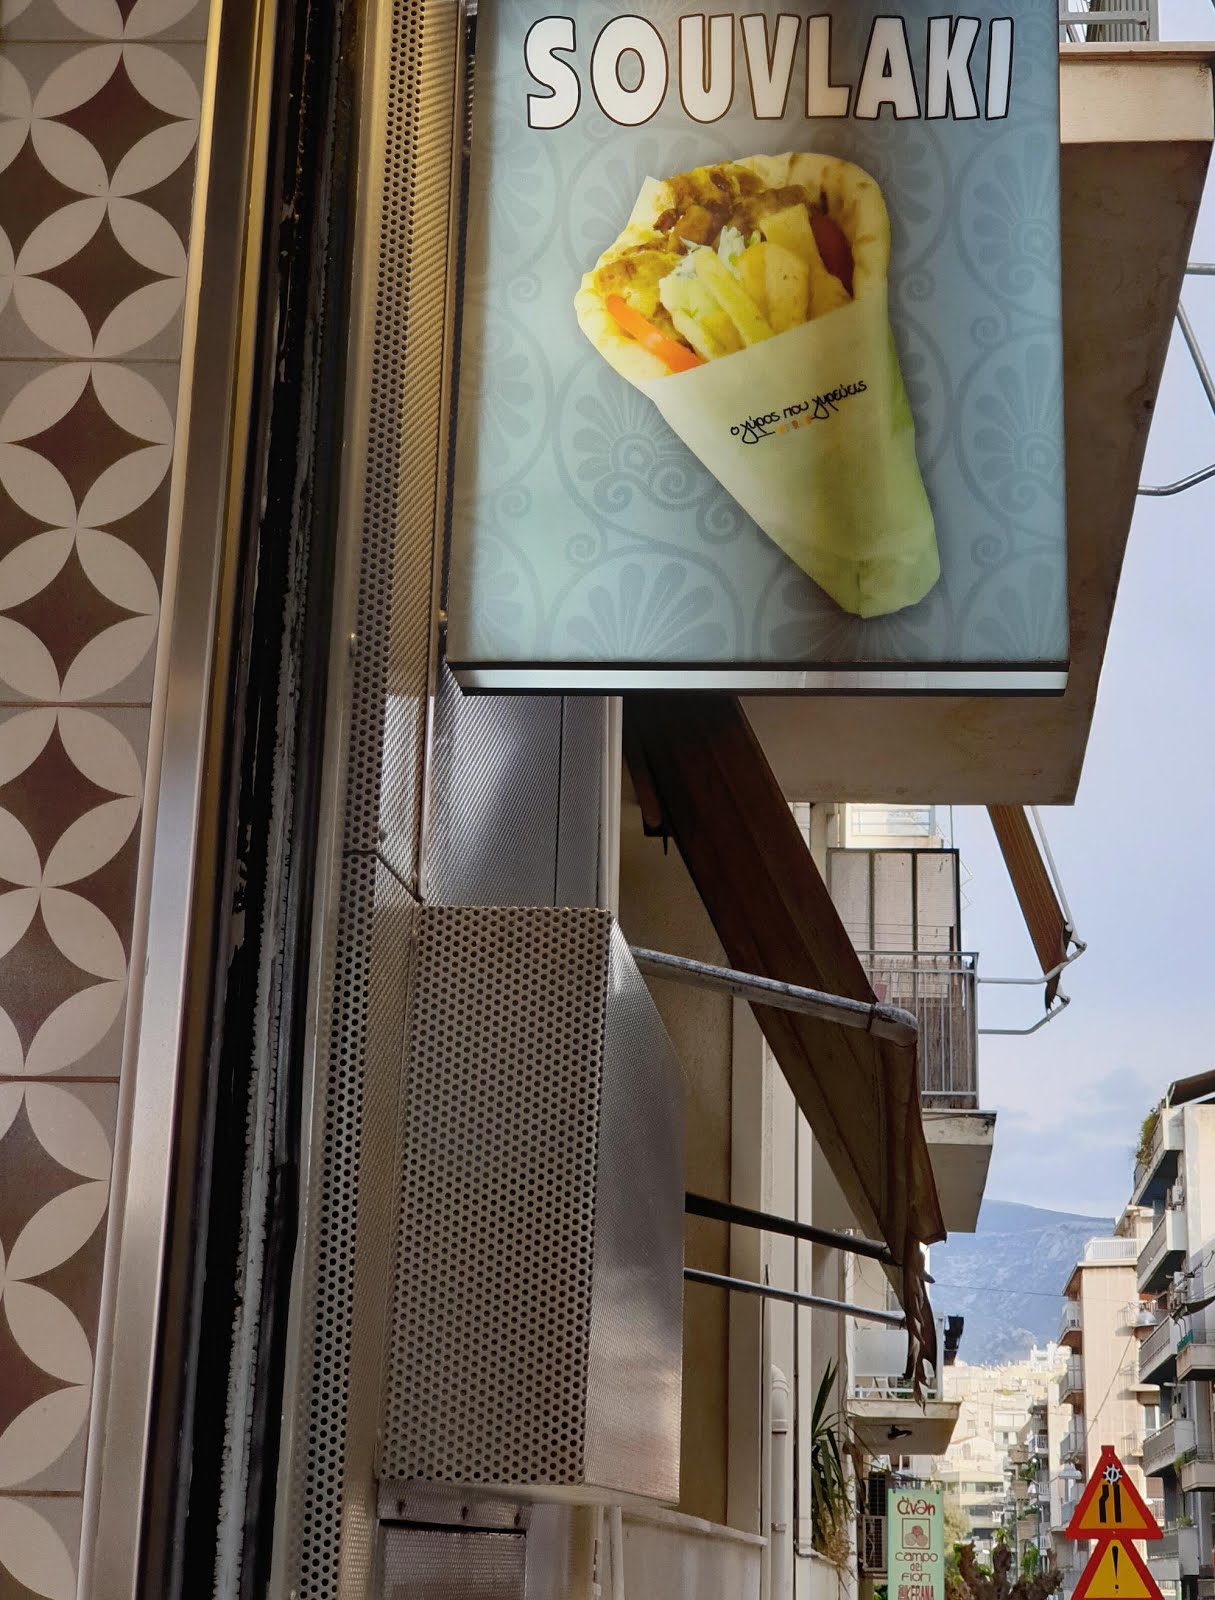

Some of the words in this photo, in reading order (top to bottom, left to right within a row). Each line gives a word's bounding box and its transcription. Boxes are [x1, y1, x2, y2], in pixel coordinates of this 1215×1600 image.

[523, 14, 1014, 129] SOUVLAKI
[740, 411, 780, 444] γύρος
[783, 401, 809, 418] που
